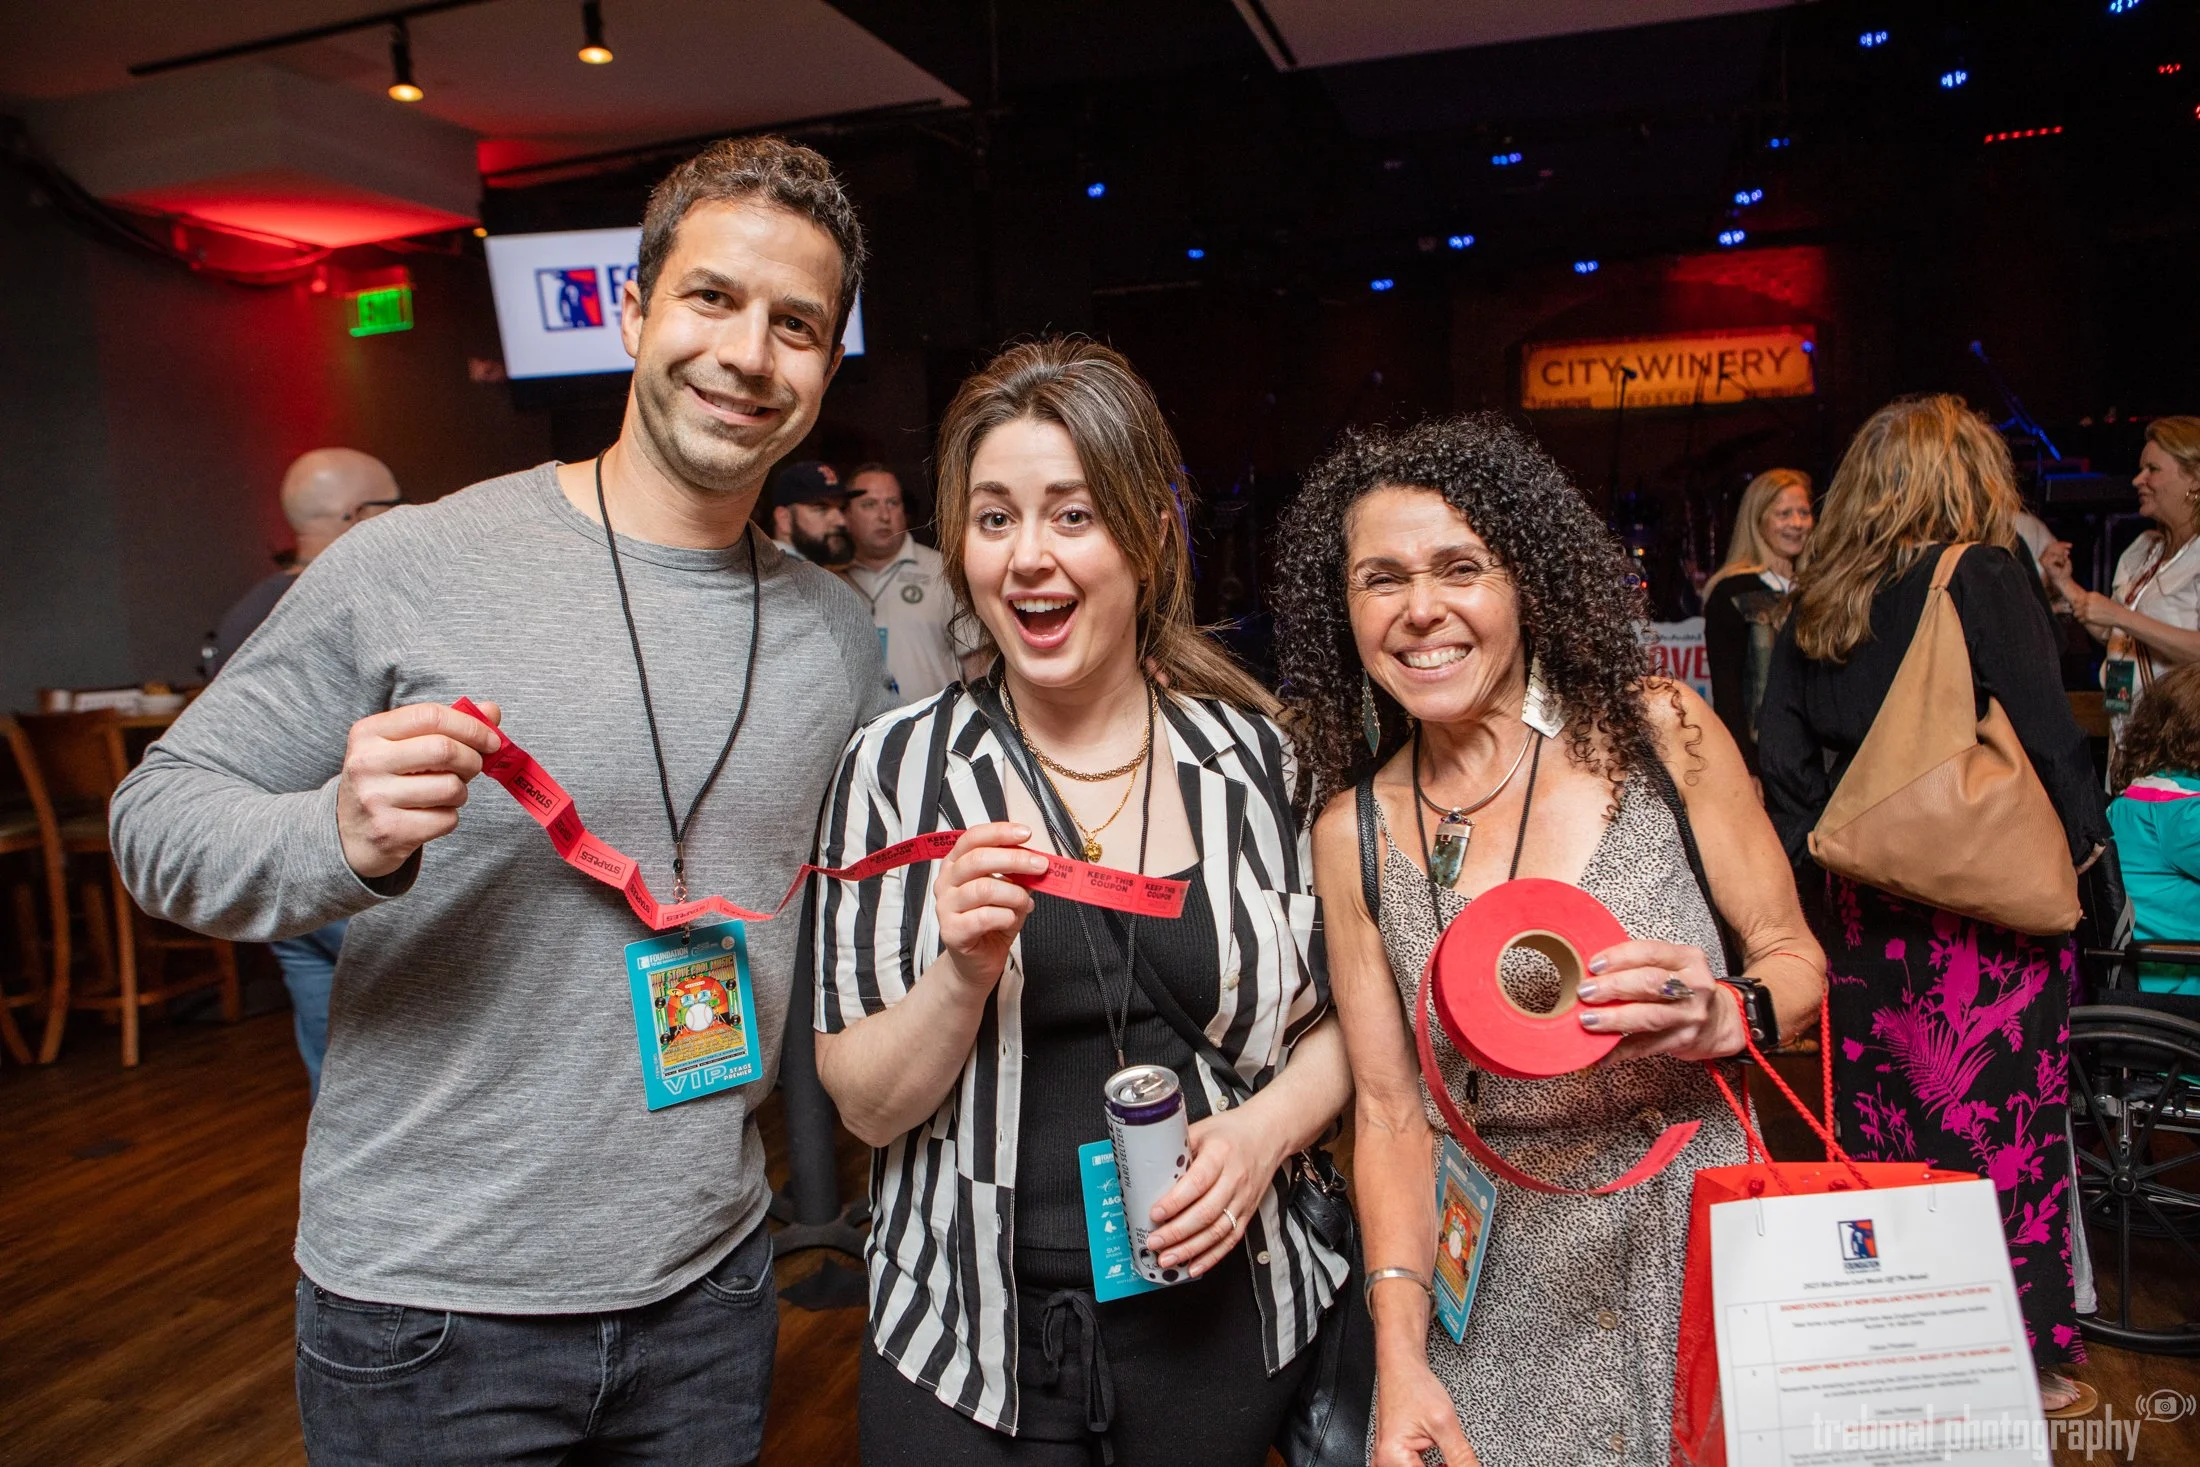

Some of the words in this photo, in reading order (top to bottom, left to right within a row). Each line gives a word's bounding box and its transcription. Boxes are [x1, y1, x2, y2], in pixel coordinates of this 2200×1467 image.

[1541, 356, 1623, 387] CITY
[1636, 345, 1791, 381] WINERY
[1627, 391, 1705, 406] BOSTO
[514, 775, 553, 809] STAPLES
[580, 850, 621, 875] STAPLES
[1053, 862, 1073, 873] THIS
[1048, 868, 1067, 879] PON
[1087, 871, 1112, 881] KEEP
[1115, 877, 1134, 887] THIS
[1090, 879, 1129, 893] COUPON
[1145, 883, 1163, 891] KEEP
[1164, 886, 1175, 894] THIS
[1147, 890, 1172, 900] COUPON
[650, 947, 688, 962] FOUNDATION
[723, 1068, 752, 1081] PREMIER
[729, 1063, 752, 1073] STAGE
[662, 1065, 727, 1095] VIP
[1116, 1127, 1128, 1163] SELTZER
[1122, 1164, 1132, 1188] HARD
